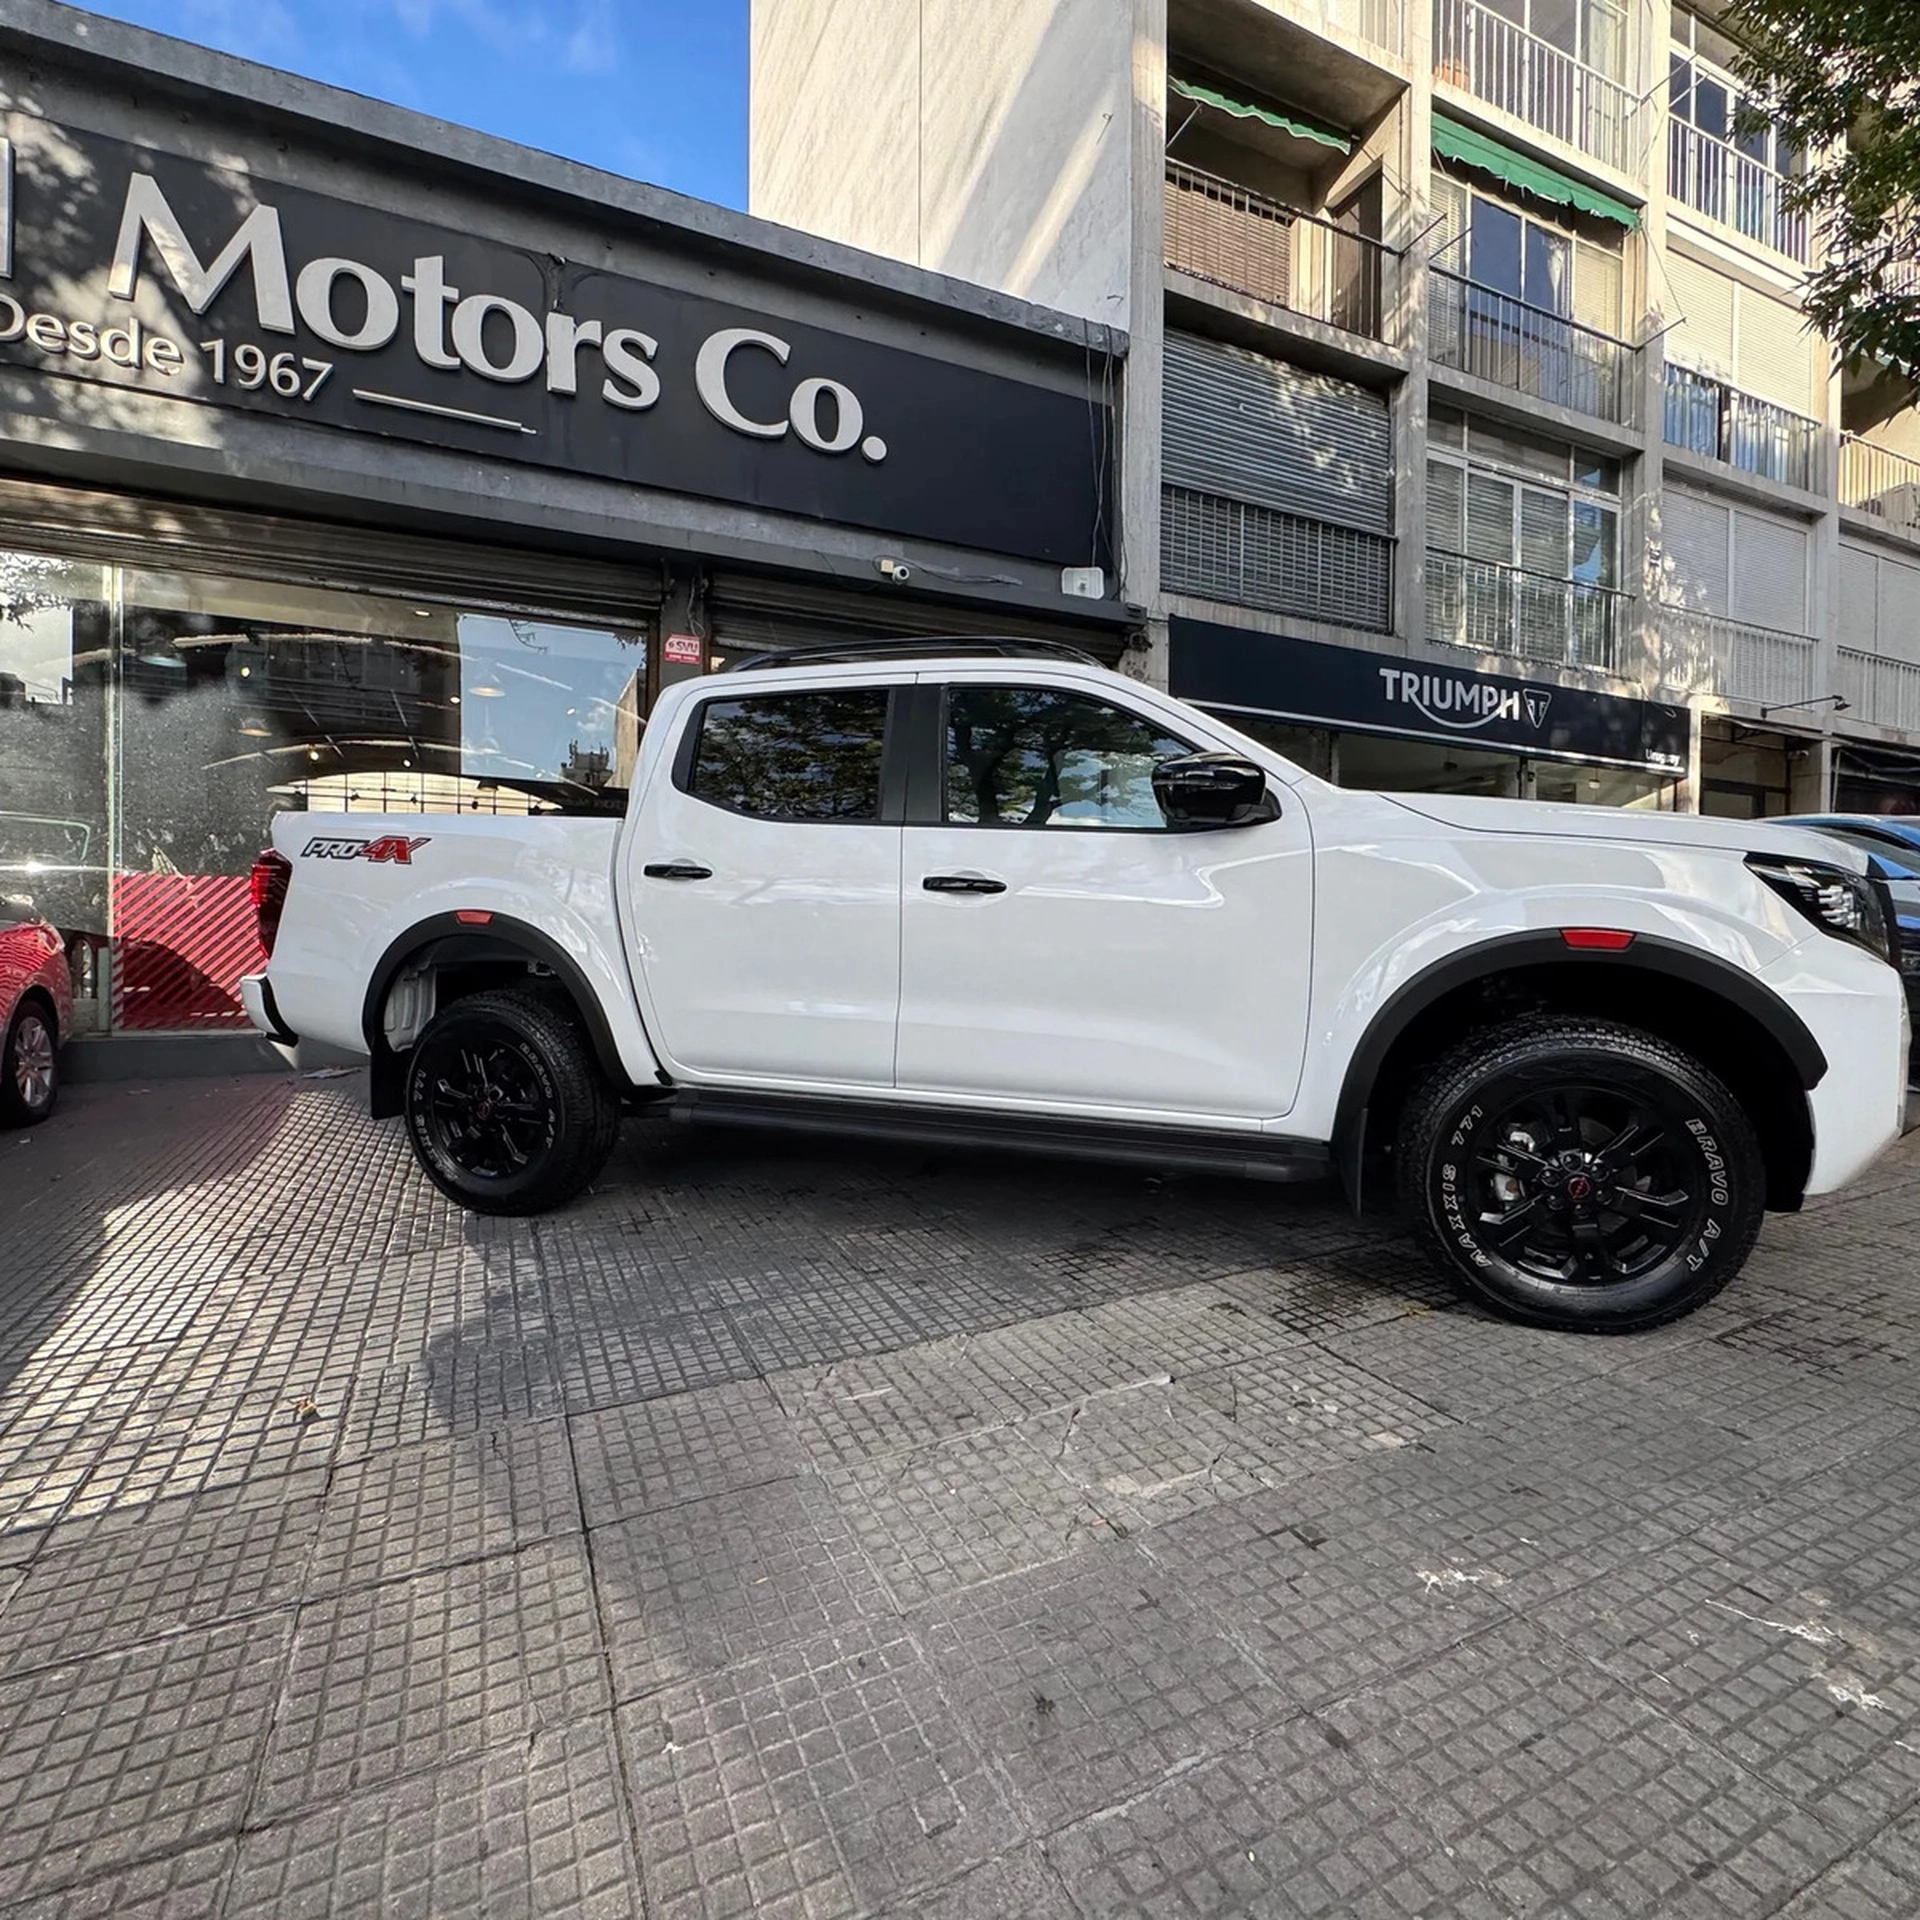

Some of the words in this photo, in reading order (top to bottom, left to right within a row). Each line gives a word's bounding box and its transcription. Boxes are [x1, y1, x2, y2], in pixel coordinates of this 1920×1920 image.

[107, 171, 661, 411] Motors
[695, 327, 888, 464] Co.
[201, 337, 334, 401] 1967
[1379, 667, 1520, 728] TRIUMPH
[1451, 1105, 1483, 1146] 771
[1685, 1117, 1729, 1206] BRAVO
[1442, 1163, 1492, 1268] MAXXIS
[1686, 1218, 1721, 1272] A/T
